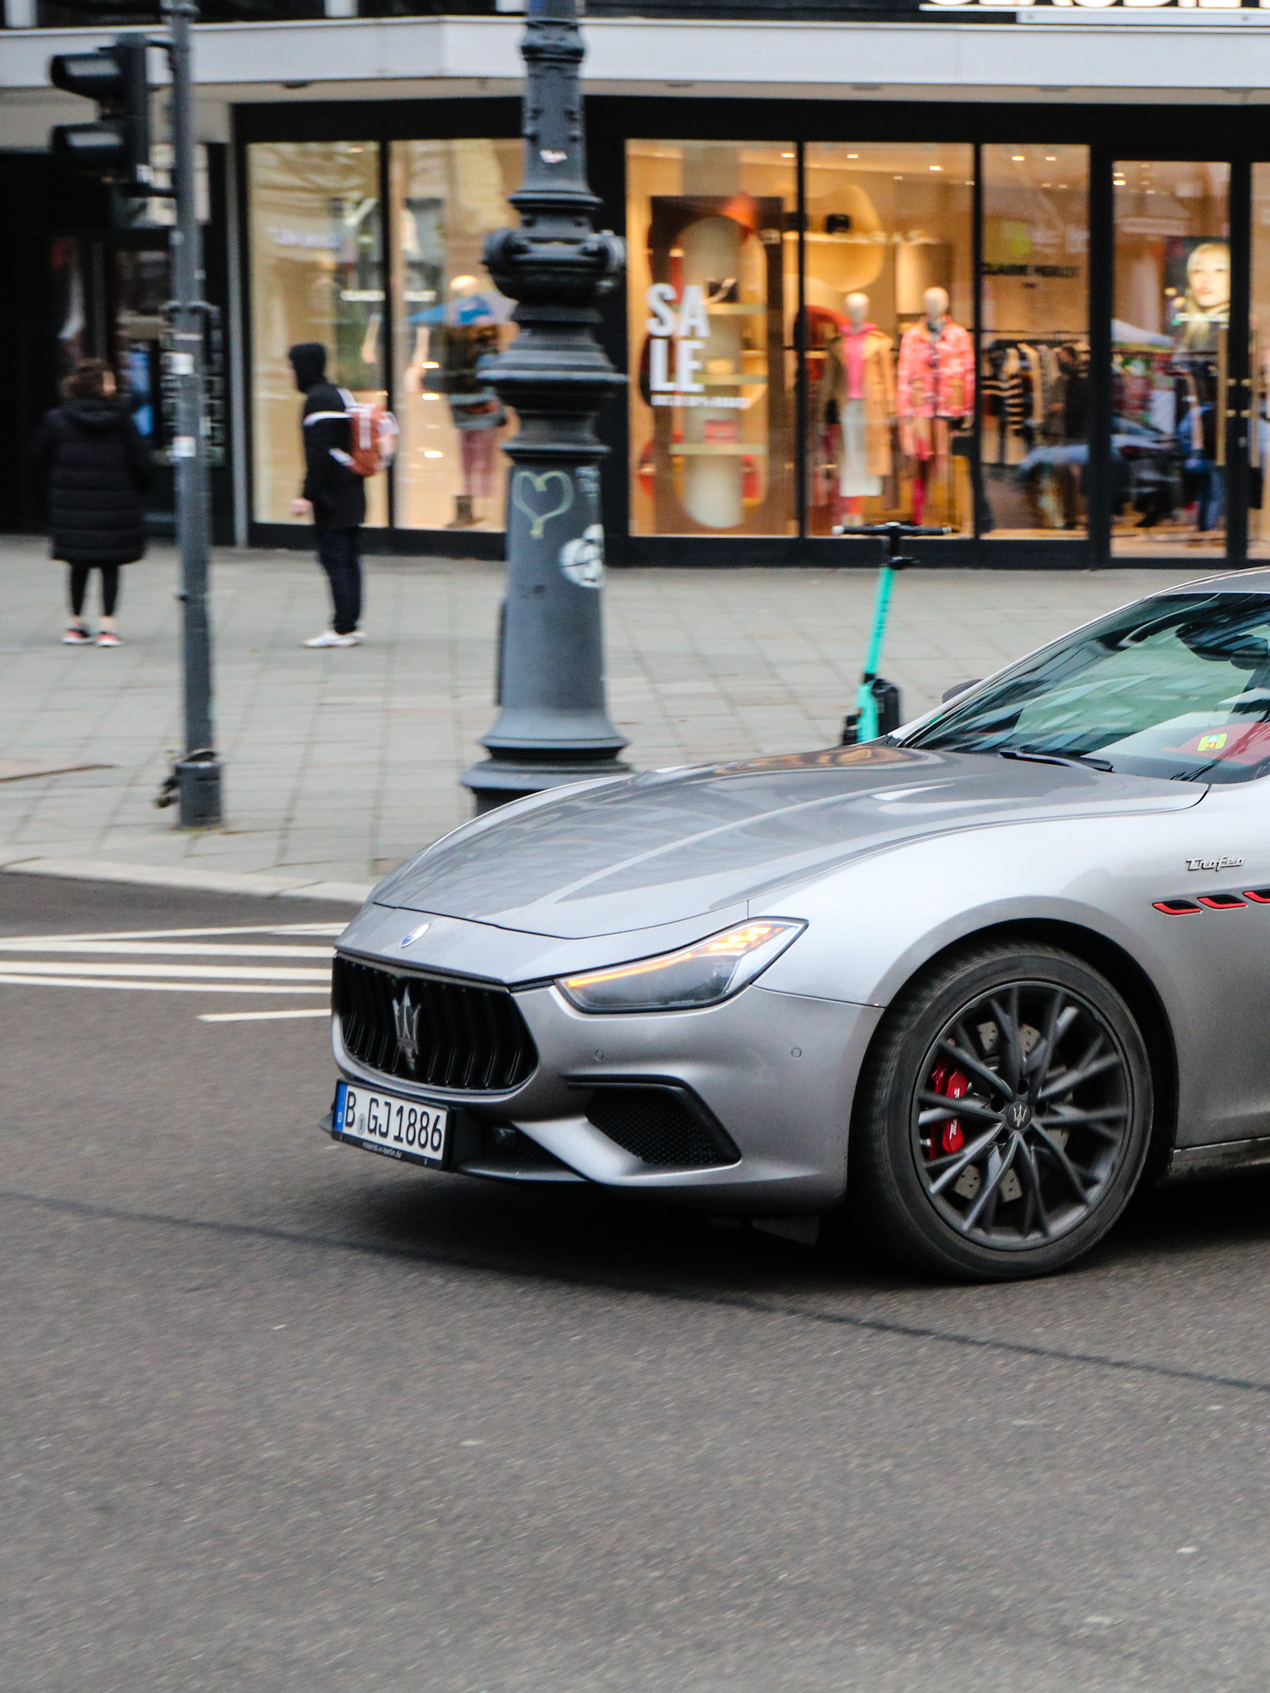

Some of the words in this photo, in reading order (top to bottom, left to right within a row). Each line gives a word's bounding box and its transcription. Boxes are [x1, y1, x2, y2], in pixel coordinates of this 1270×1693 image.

[645, 283, 711, 337] SA
[650, 338, 705, 392] LE
[1186, 855, 1246, 872] Trofeo
[345, 1091, 356, 1128] B
